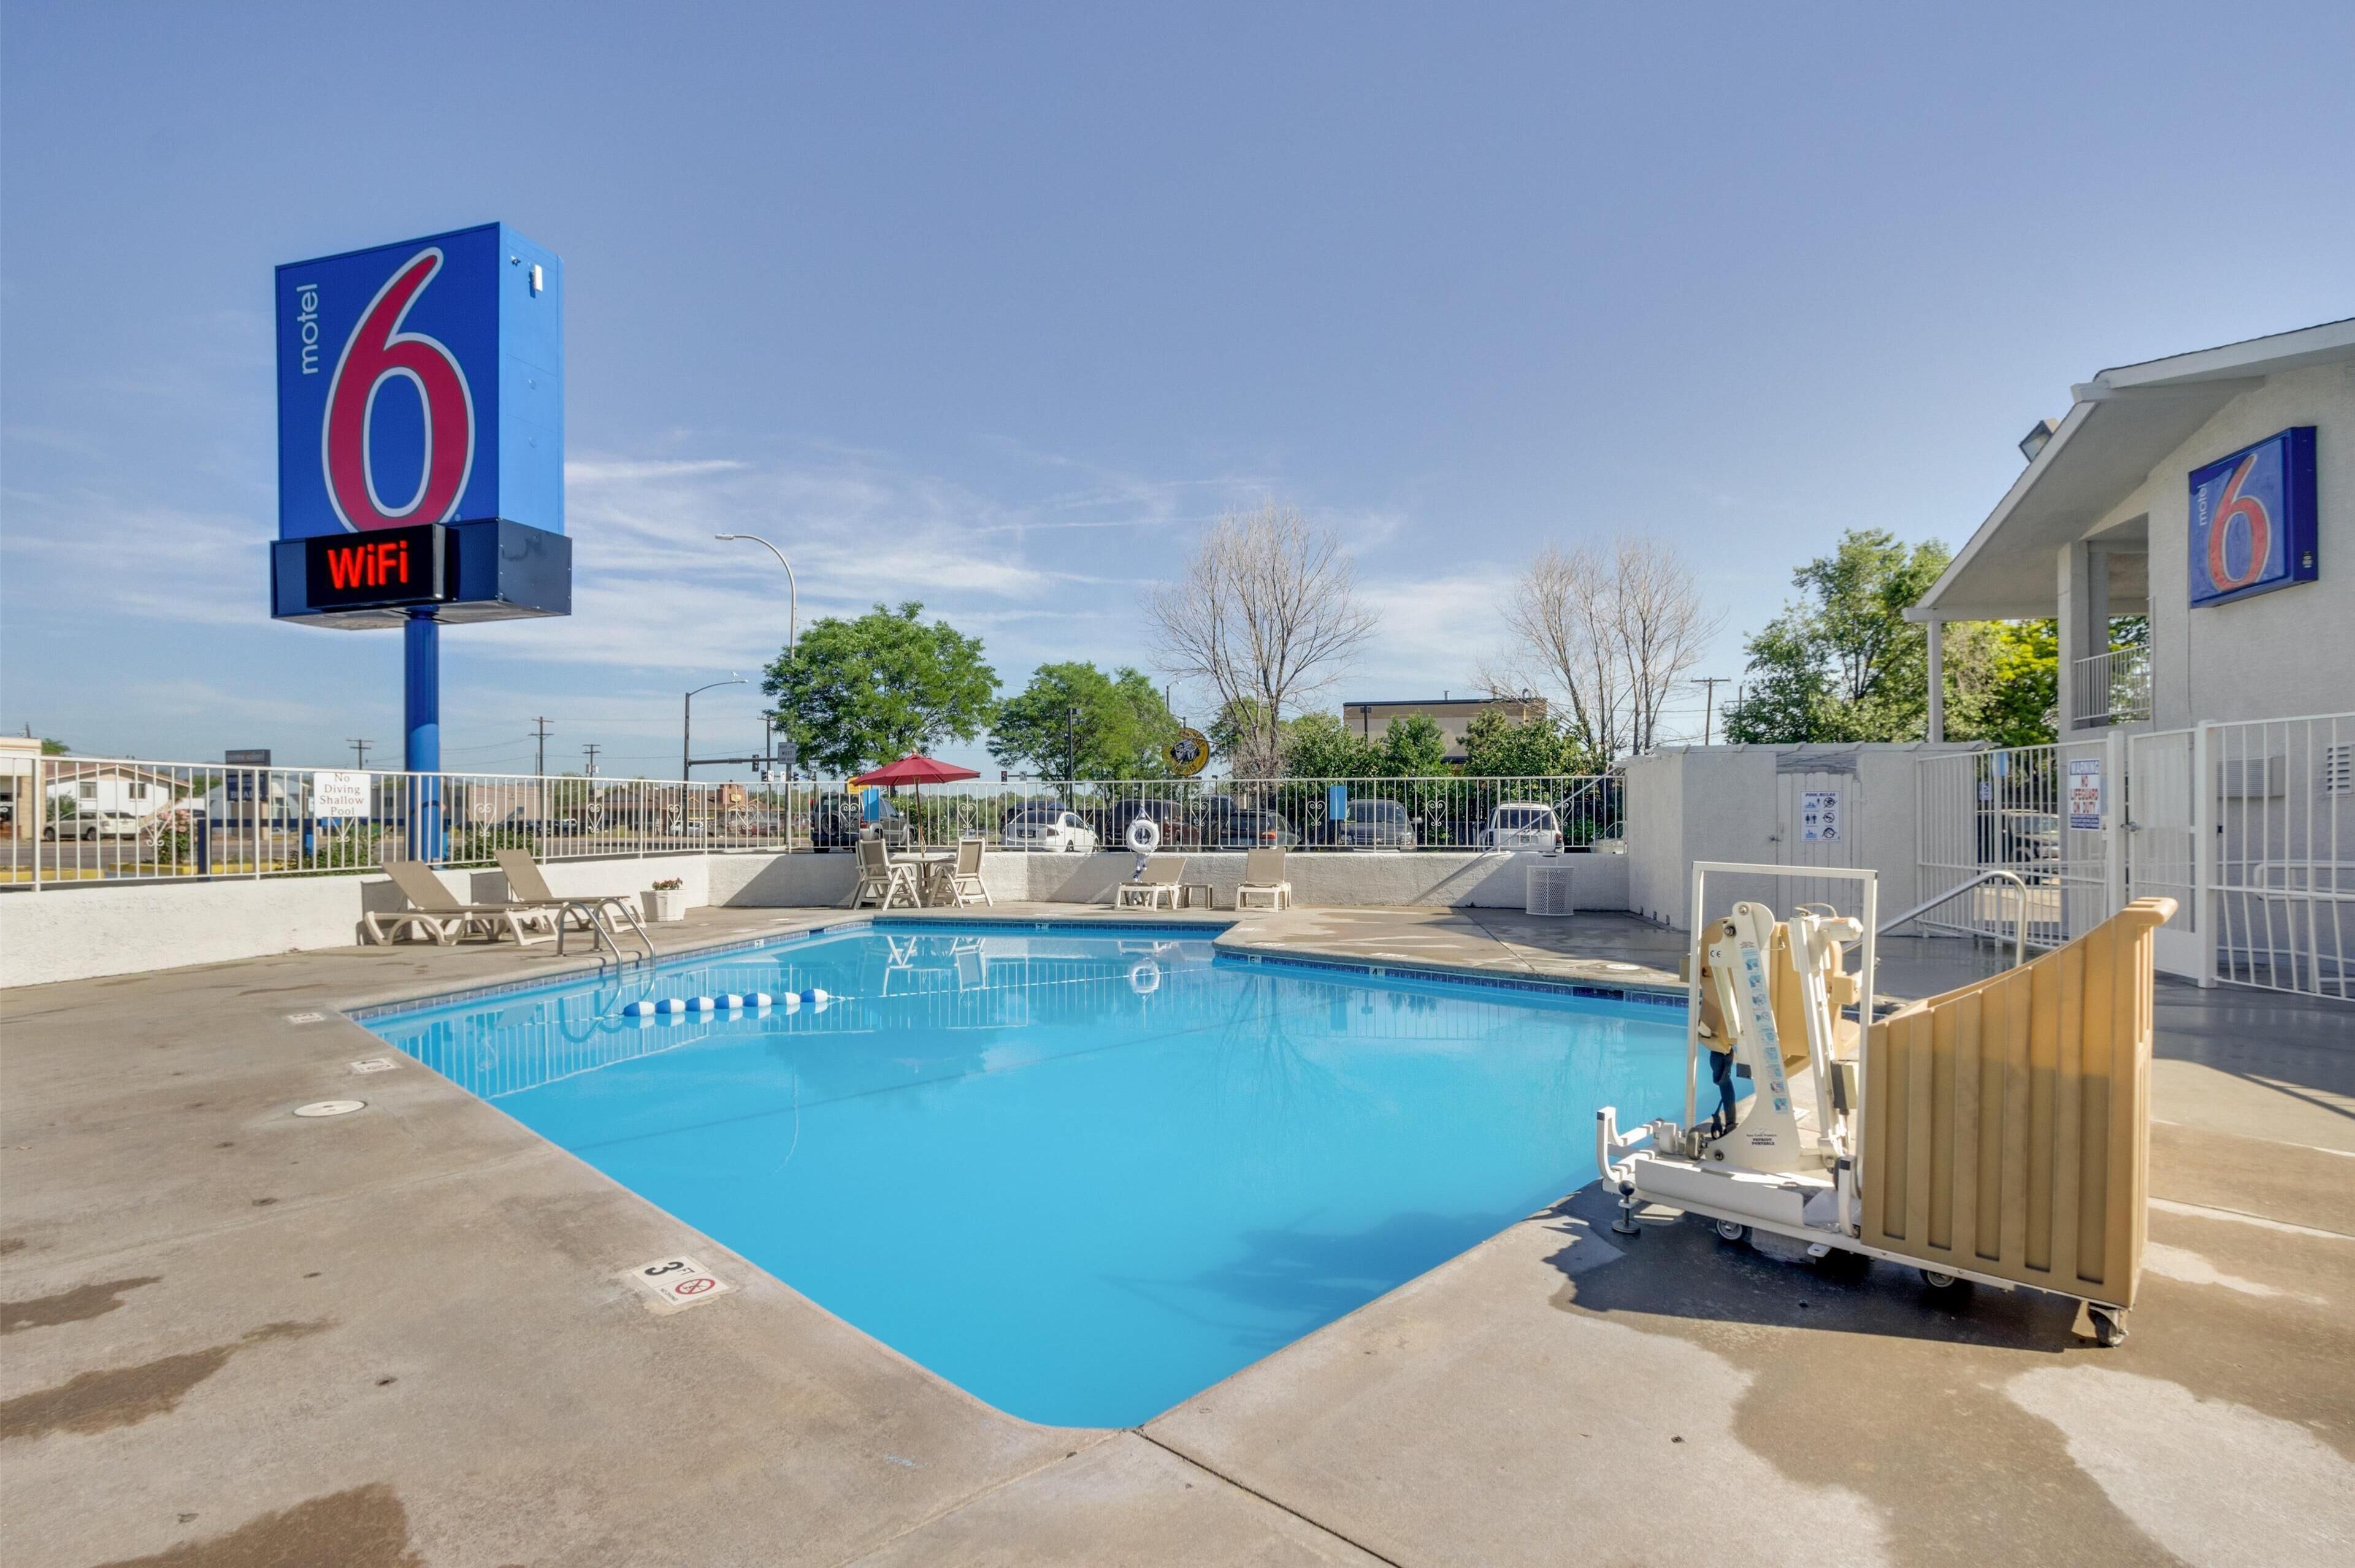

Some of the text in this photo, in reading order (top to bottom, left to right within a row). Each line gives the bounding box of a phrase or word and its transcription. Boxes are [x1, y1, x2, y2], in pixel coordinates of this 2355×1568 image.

[296, 246, 475, 533] motel 6
[2197, 453, 2270, 593] motel 6
[327, 540, 408, 589] WiFi
[2070, 761, 2099, 774] WARNING
[334, 773, 350, 782] No
[324, 784, 361, 795] Diving
[2070, 789, 2098, 800] LIFEGUARD
[320, 795, 364, 804] Shallow
[331, 806, 354, 815] Pool
[2074, 801, 2096, 814] ON DUTY
[644, 1261, 684, 1276] 3
